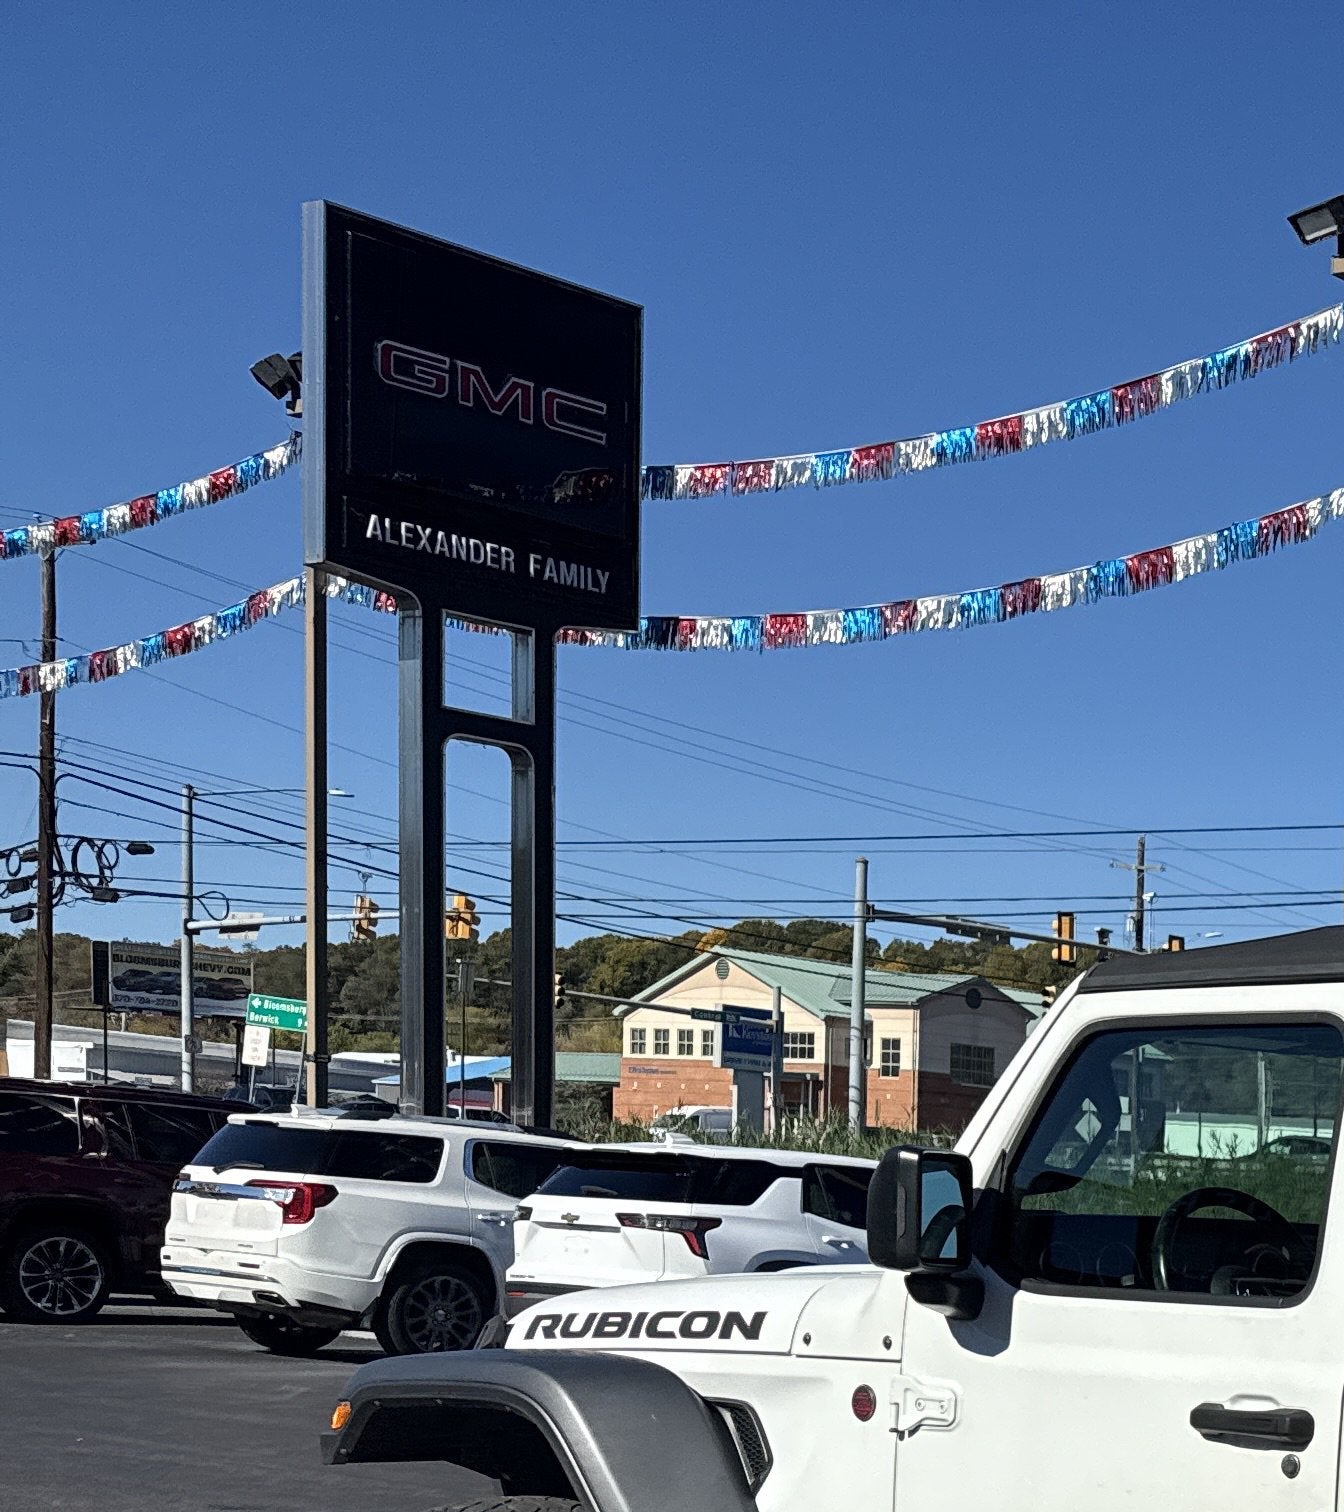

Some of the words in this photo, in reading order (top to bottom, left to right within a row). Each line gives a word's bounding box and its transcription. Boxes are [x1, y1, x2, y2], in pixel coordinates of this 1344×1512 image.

[378, 339, 607, 445] GMC
[366, 513, 516, 574] ALEXANDER
[529, 553, 610, 594] FAMILY
[523, 1310, 769, 1341] RUBICON
